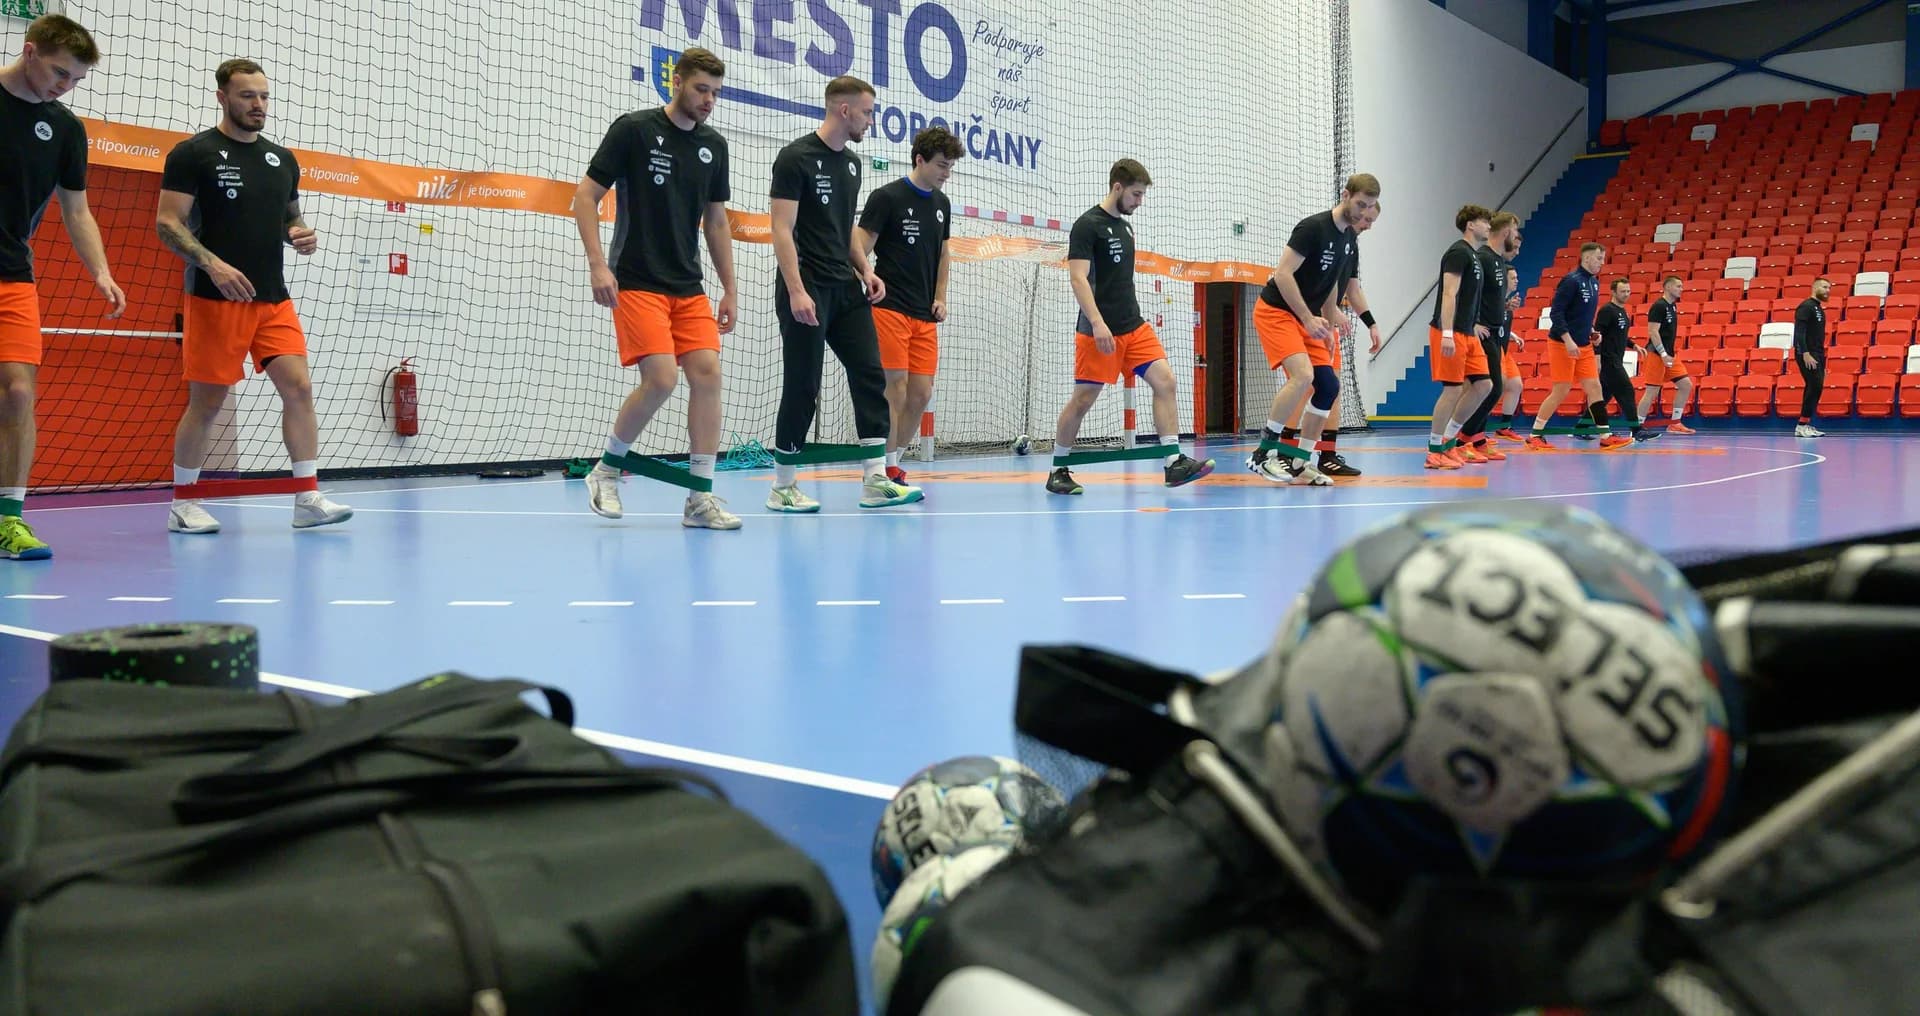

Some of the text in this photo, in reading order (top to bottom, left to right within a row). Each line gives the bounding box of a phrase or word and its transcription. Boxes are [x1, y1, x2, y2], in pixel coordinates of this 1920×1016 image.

[972, 20, 1044, 64] Podporuje
[997, 62, 1023, 82] náš
[990, 90, 1031, 119] šport
[96, 136, 161, 159] tipovanie
[309, 166, 360, 185] tipovanie
[417, 175, 458, 200] niké
[478, 184, 527, 199] tipovanie
[1410, 552, 1697, 751] SELECT
[893, 792, 938, 869] SELE
